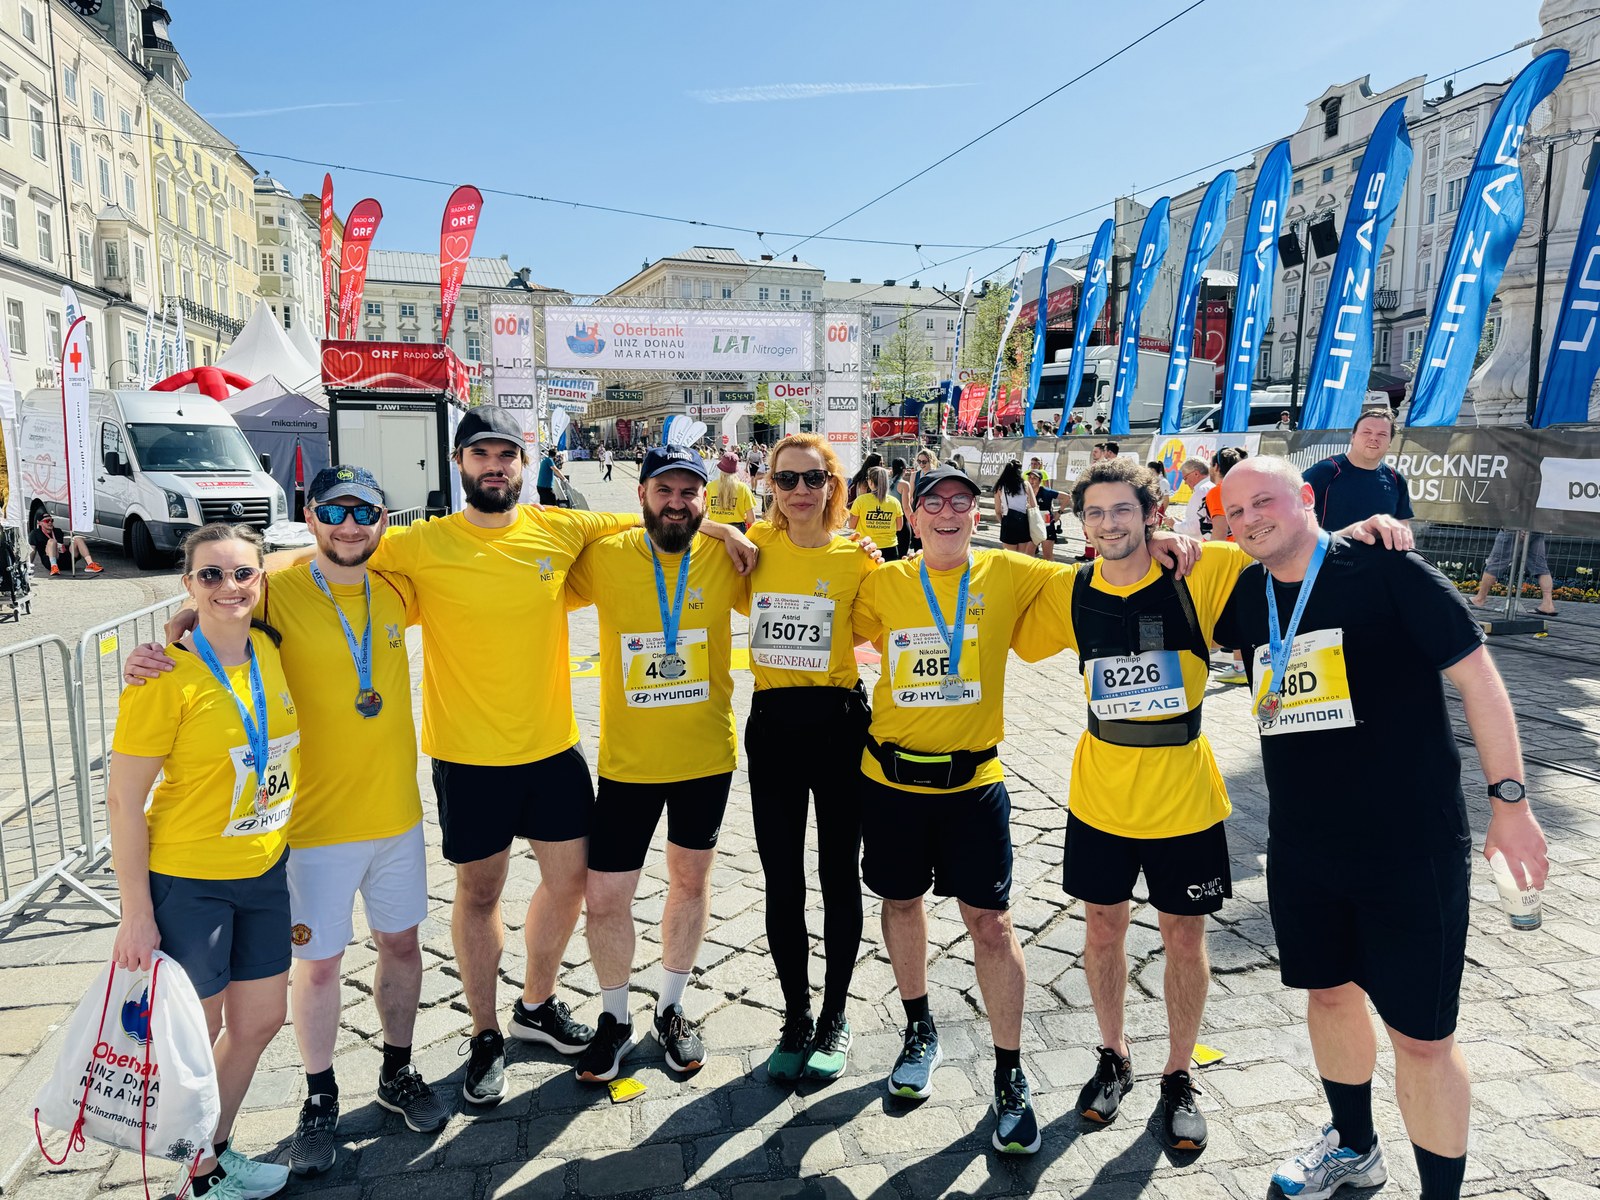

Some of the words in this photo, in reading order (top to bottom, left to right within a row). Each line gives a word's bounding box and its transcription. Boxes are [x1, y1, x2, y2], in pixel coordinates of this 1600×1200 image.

[451, 216, 474, 227] ORF
[353, 227, 372, 237] ORF
[1255, 200, 1276, 272] AG
[1430, 230, 1490, 368] LINZ
[1482, 124, 1524, 216] AG
[1323, 266, 1370, 390] LINZ
[1356, 172, 1386, 253] AG
[494, 314, 530, 336] OÖN
[613, 323, 684, 337] Oberbank
[828, 322, 858, 342] OÖN
[614, 339, 638, 347] LINZ
[644, 339, 684, 348] DONAU
[712, 335, 751, 354] LAT
[753, 344, 798, 357] Nitrogen
[372, 350, 399, 359] ORF
[614, 350, 685, 359] MARATHON
[271, 419, 318, 429] mika:timing
[1384, 455, 1508, 478] BRUCKNER
[1569, 481, 1600, 500] pos
[540, 573, 554, 581] NET
[762, 621, 820, 642] 15073
[390, 640, 402, 648] NET
[770, 654, 821, 668] GENERALI
[1286, 661, 1307, 671] olfgang
[1104, 664, 1160, 688] 8226
[654, 688, 703, 701] HYUNDAI
[1097, 702, 1142, 715] LINZ
[1148, 697, 1180, 710] AG
[1280, 709, 1343, 725] HYUNDAI
[268, 771, 290, 796] 8A
[86, 1062, 115, 1082] LINZ
